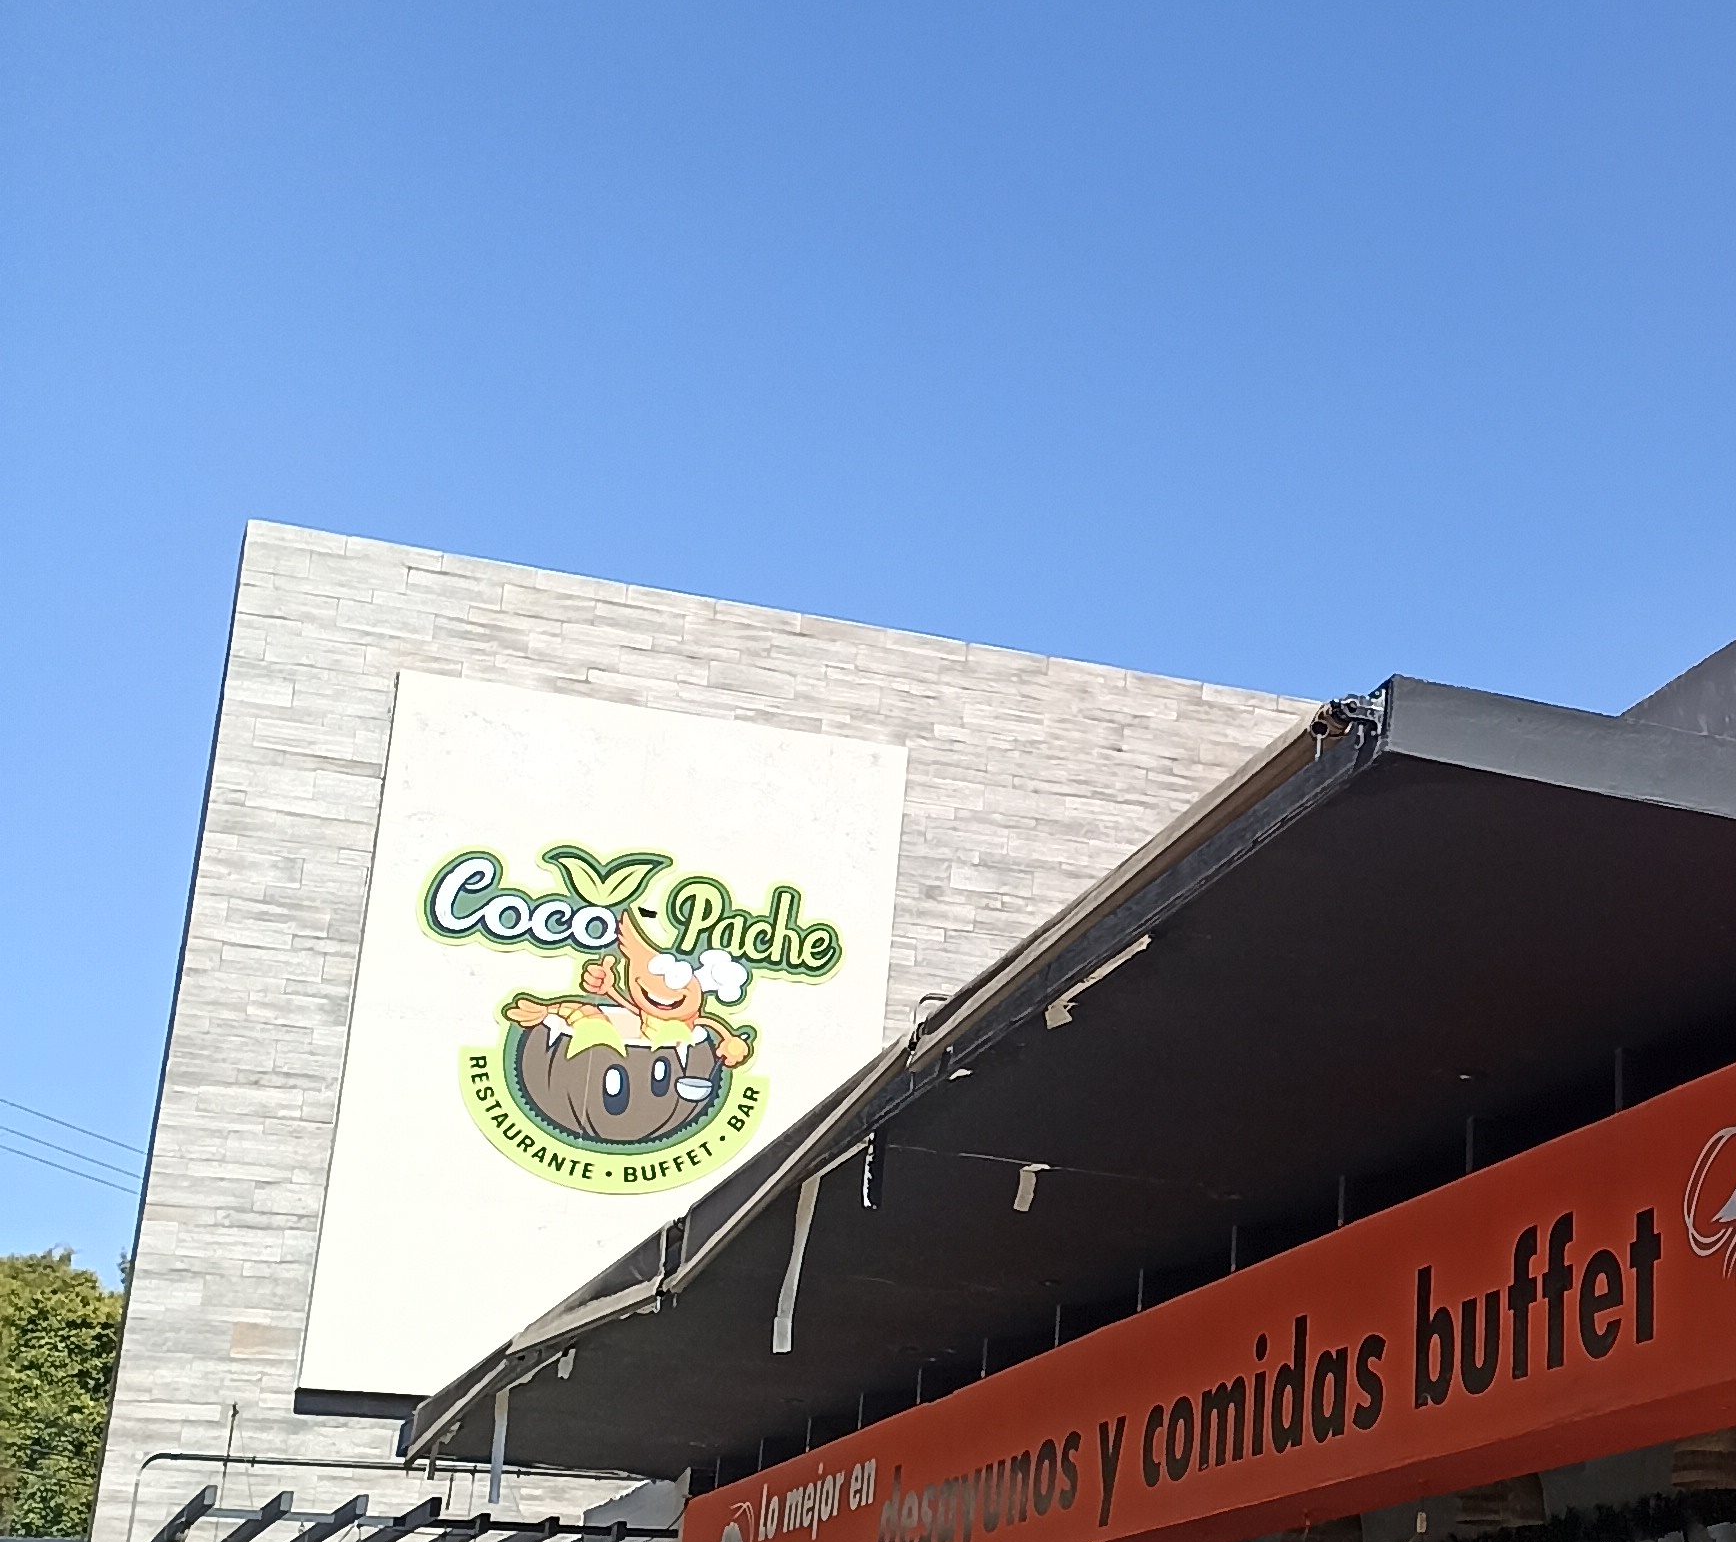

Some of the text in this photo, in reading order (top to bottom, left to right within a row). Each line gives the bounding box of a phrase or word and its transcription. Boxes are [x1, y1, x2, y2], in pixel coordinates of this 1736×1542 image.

[430, 855, 837, 969] Coco Pache
[467, 1055, 761, 1184] RESTAURANTE BUFFET BAR
[1097, 1415, 1127, 1528] y
[1141, 1314, 1387, 1488] comidas
[1414, 1207, 1662, 1410] buffet
[782, 1461, 846, 1541] mejor
[849, 1457, 877, 1511] en
